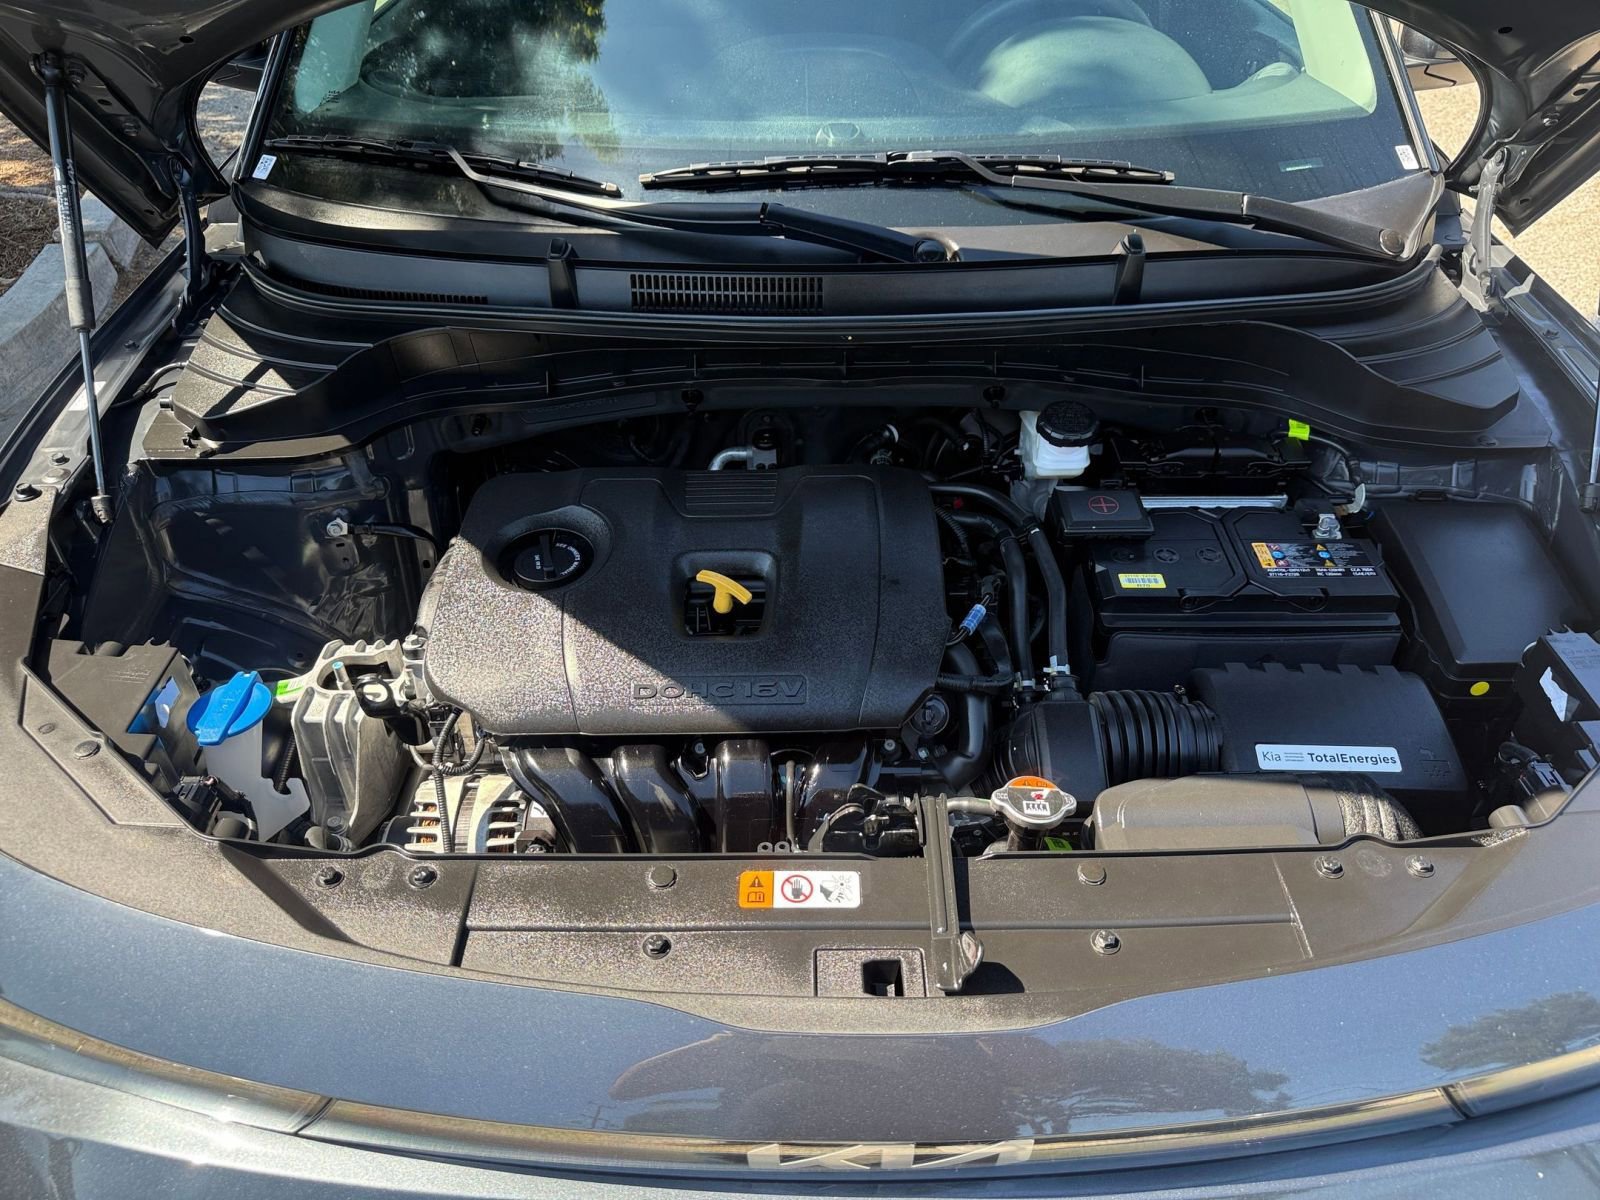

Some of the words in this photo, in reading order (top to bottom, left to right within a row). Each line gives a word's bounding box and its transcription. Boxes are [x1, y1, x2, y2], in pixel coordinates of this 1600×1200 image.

[633, 681, 735, 699] DOHC
[742, 680, 804, 698] 16V
[1262, 752, 1282, 762] Kia
[1308, 752, 1397, 765] TotalEnergies
